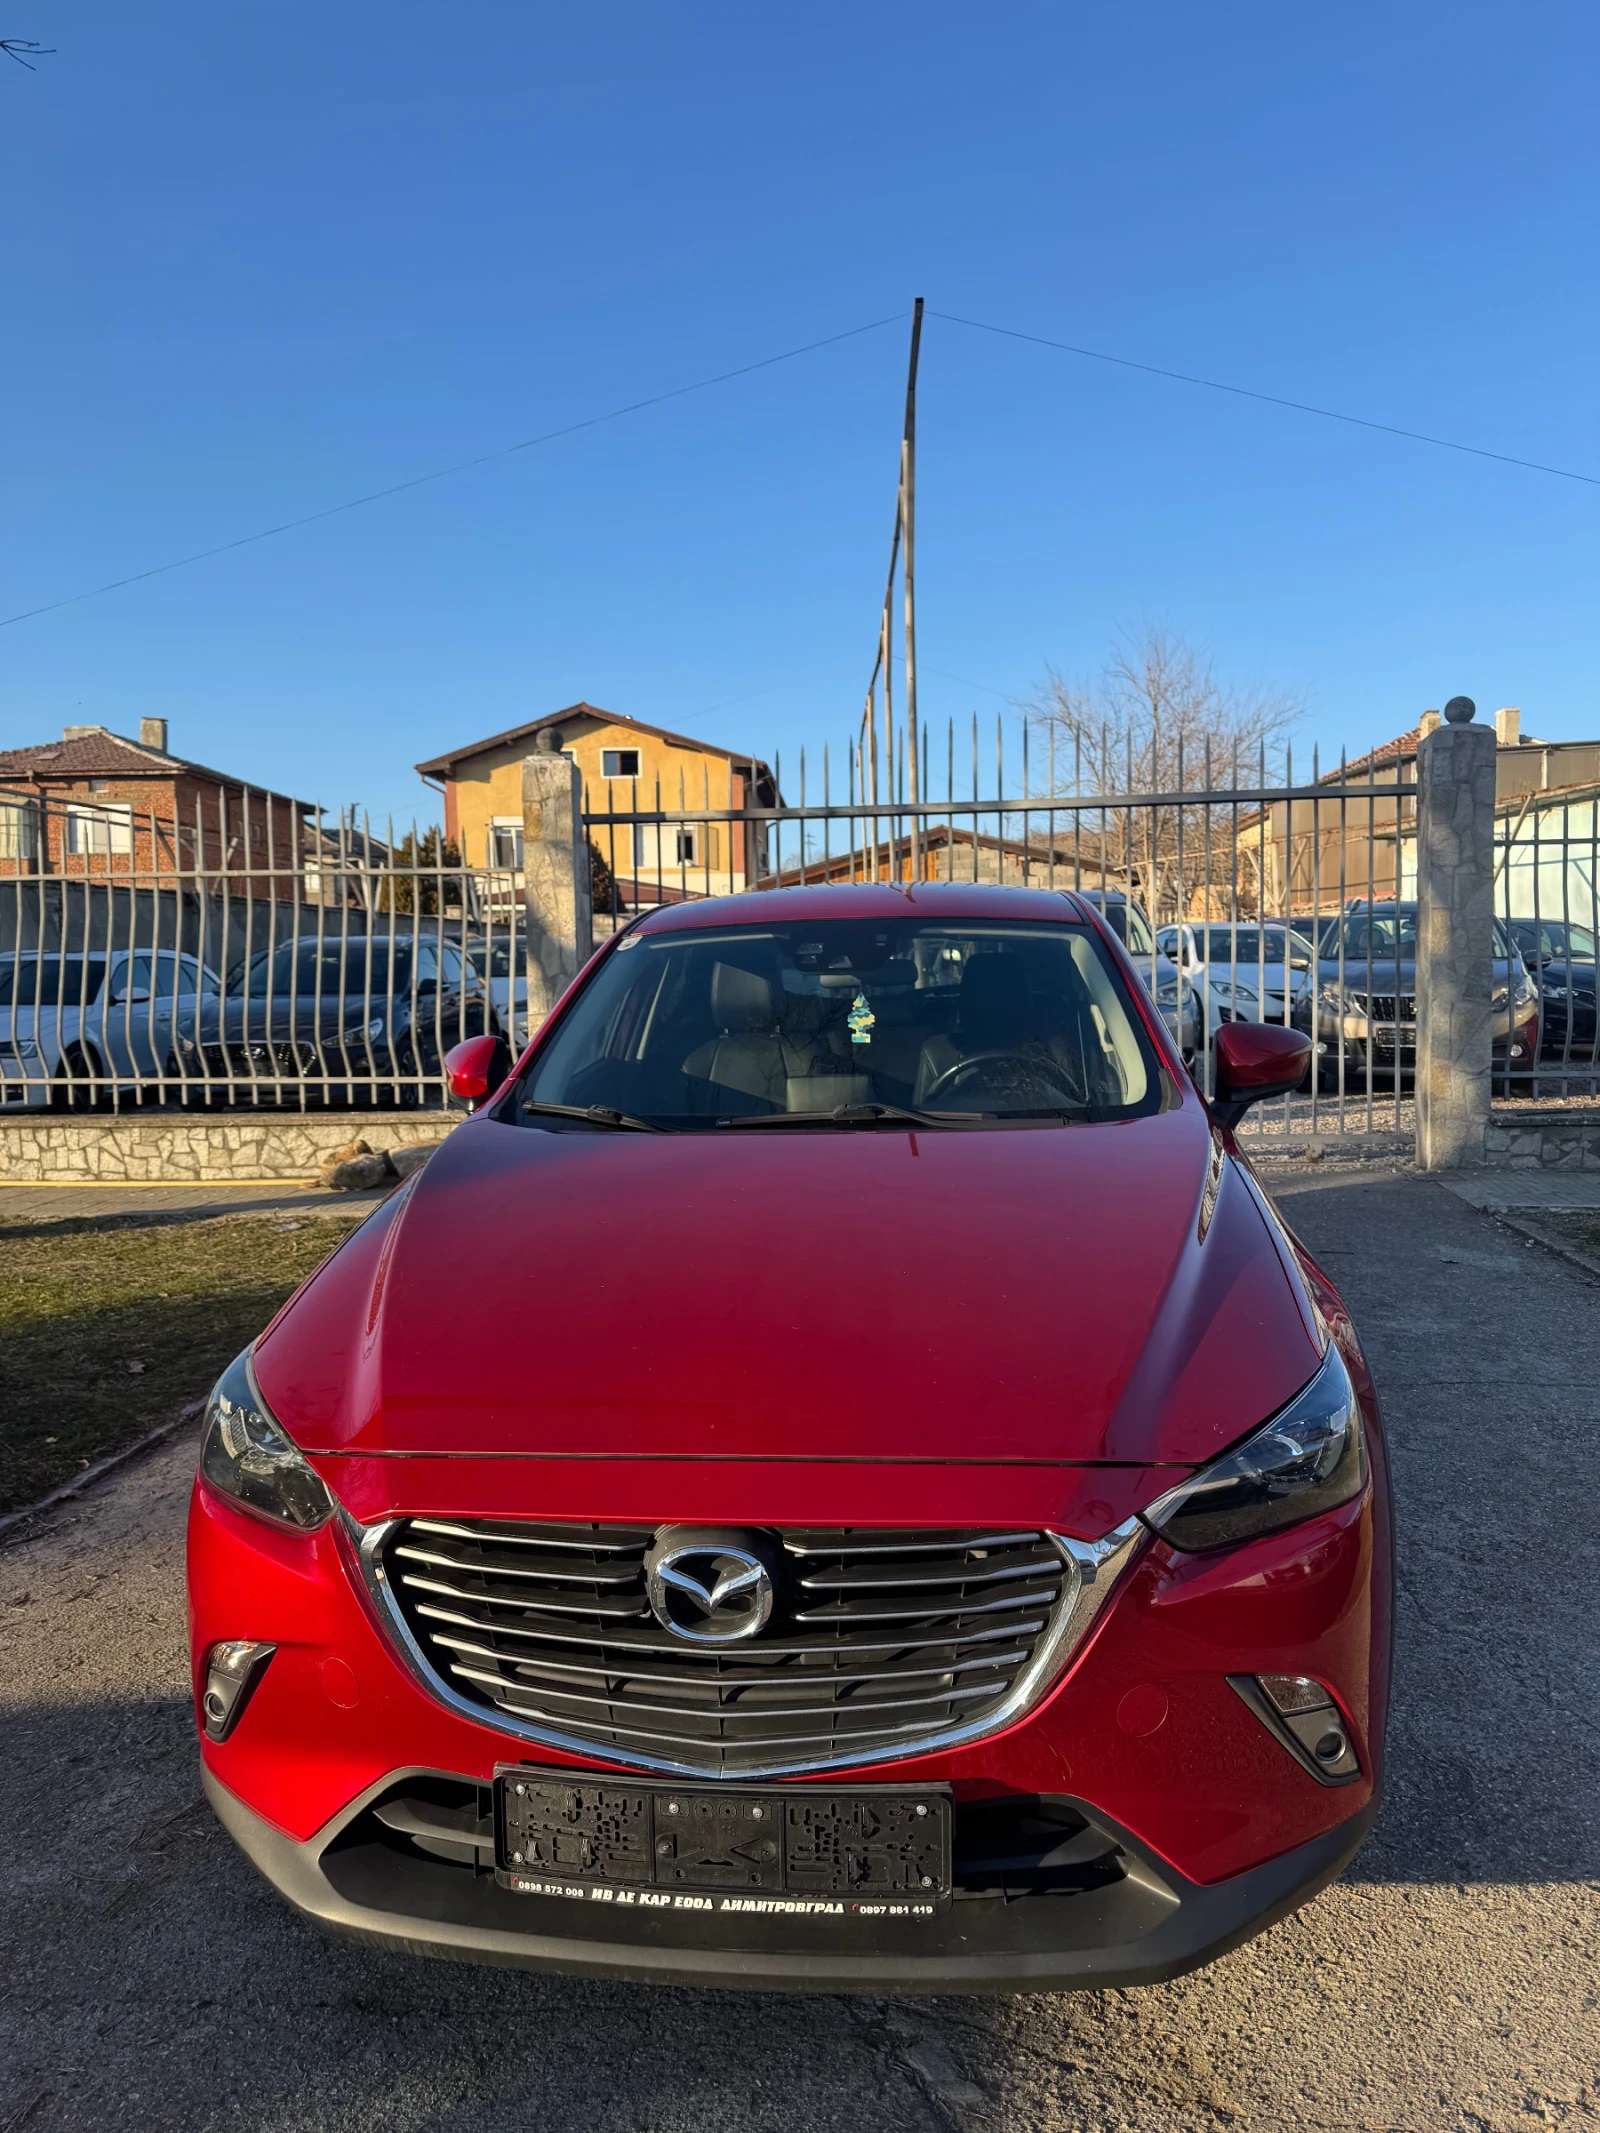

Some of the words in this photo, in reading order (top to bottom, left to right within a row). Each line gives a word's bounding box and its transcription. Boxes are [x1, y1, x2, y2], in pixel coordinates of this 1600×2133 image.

[518, 1881, 542, 1893] 0898
[545, 1885, 564, 1895] 572
[565, 1888, 585, 1898] 008
[591, 1888, 613, 1901] ИВ
[616, 1891, 636, 1903] ДЕ
[639, 1893, 671, 1906] КАР
[674, 1896, 714, 1909] ЕООД
[719, 1898, 844, 1913] ДИМИТРОВГРАД
[859, 1905, 887, 1914] 0897
[912, 1905, 934, 1914] 419
